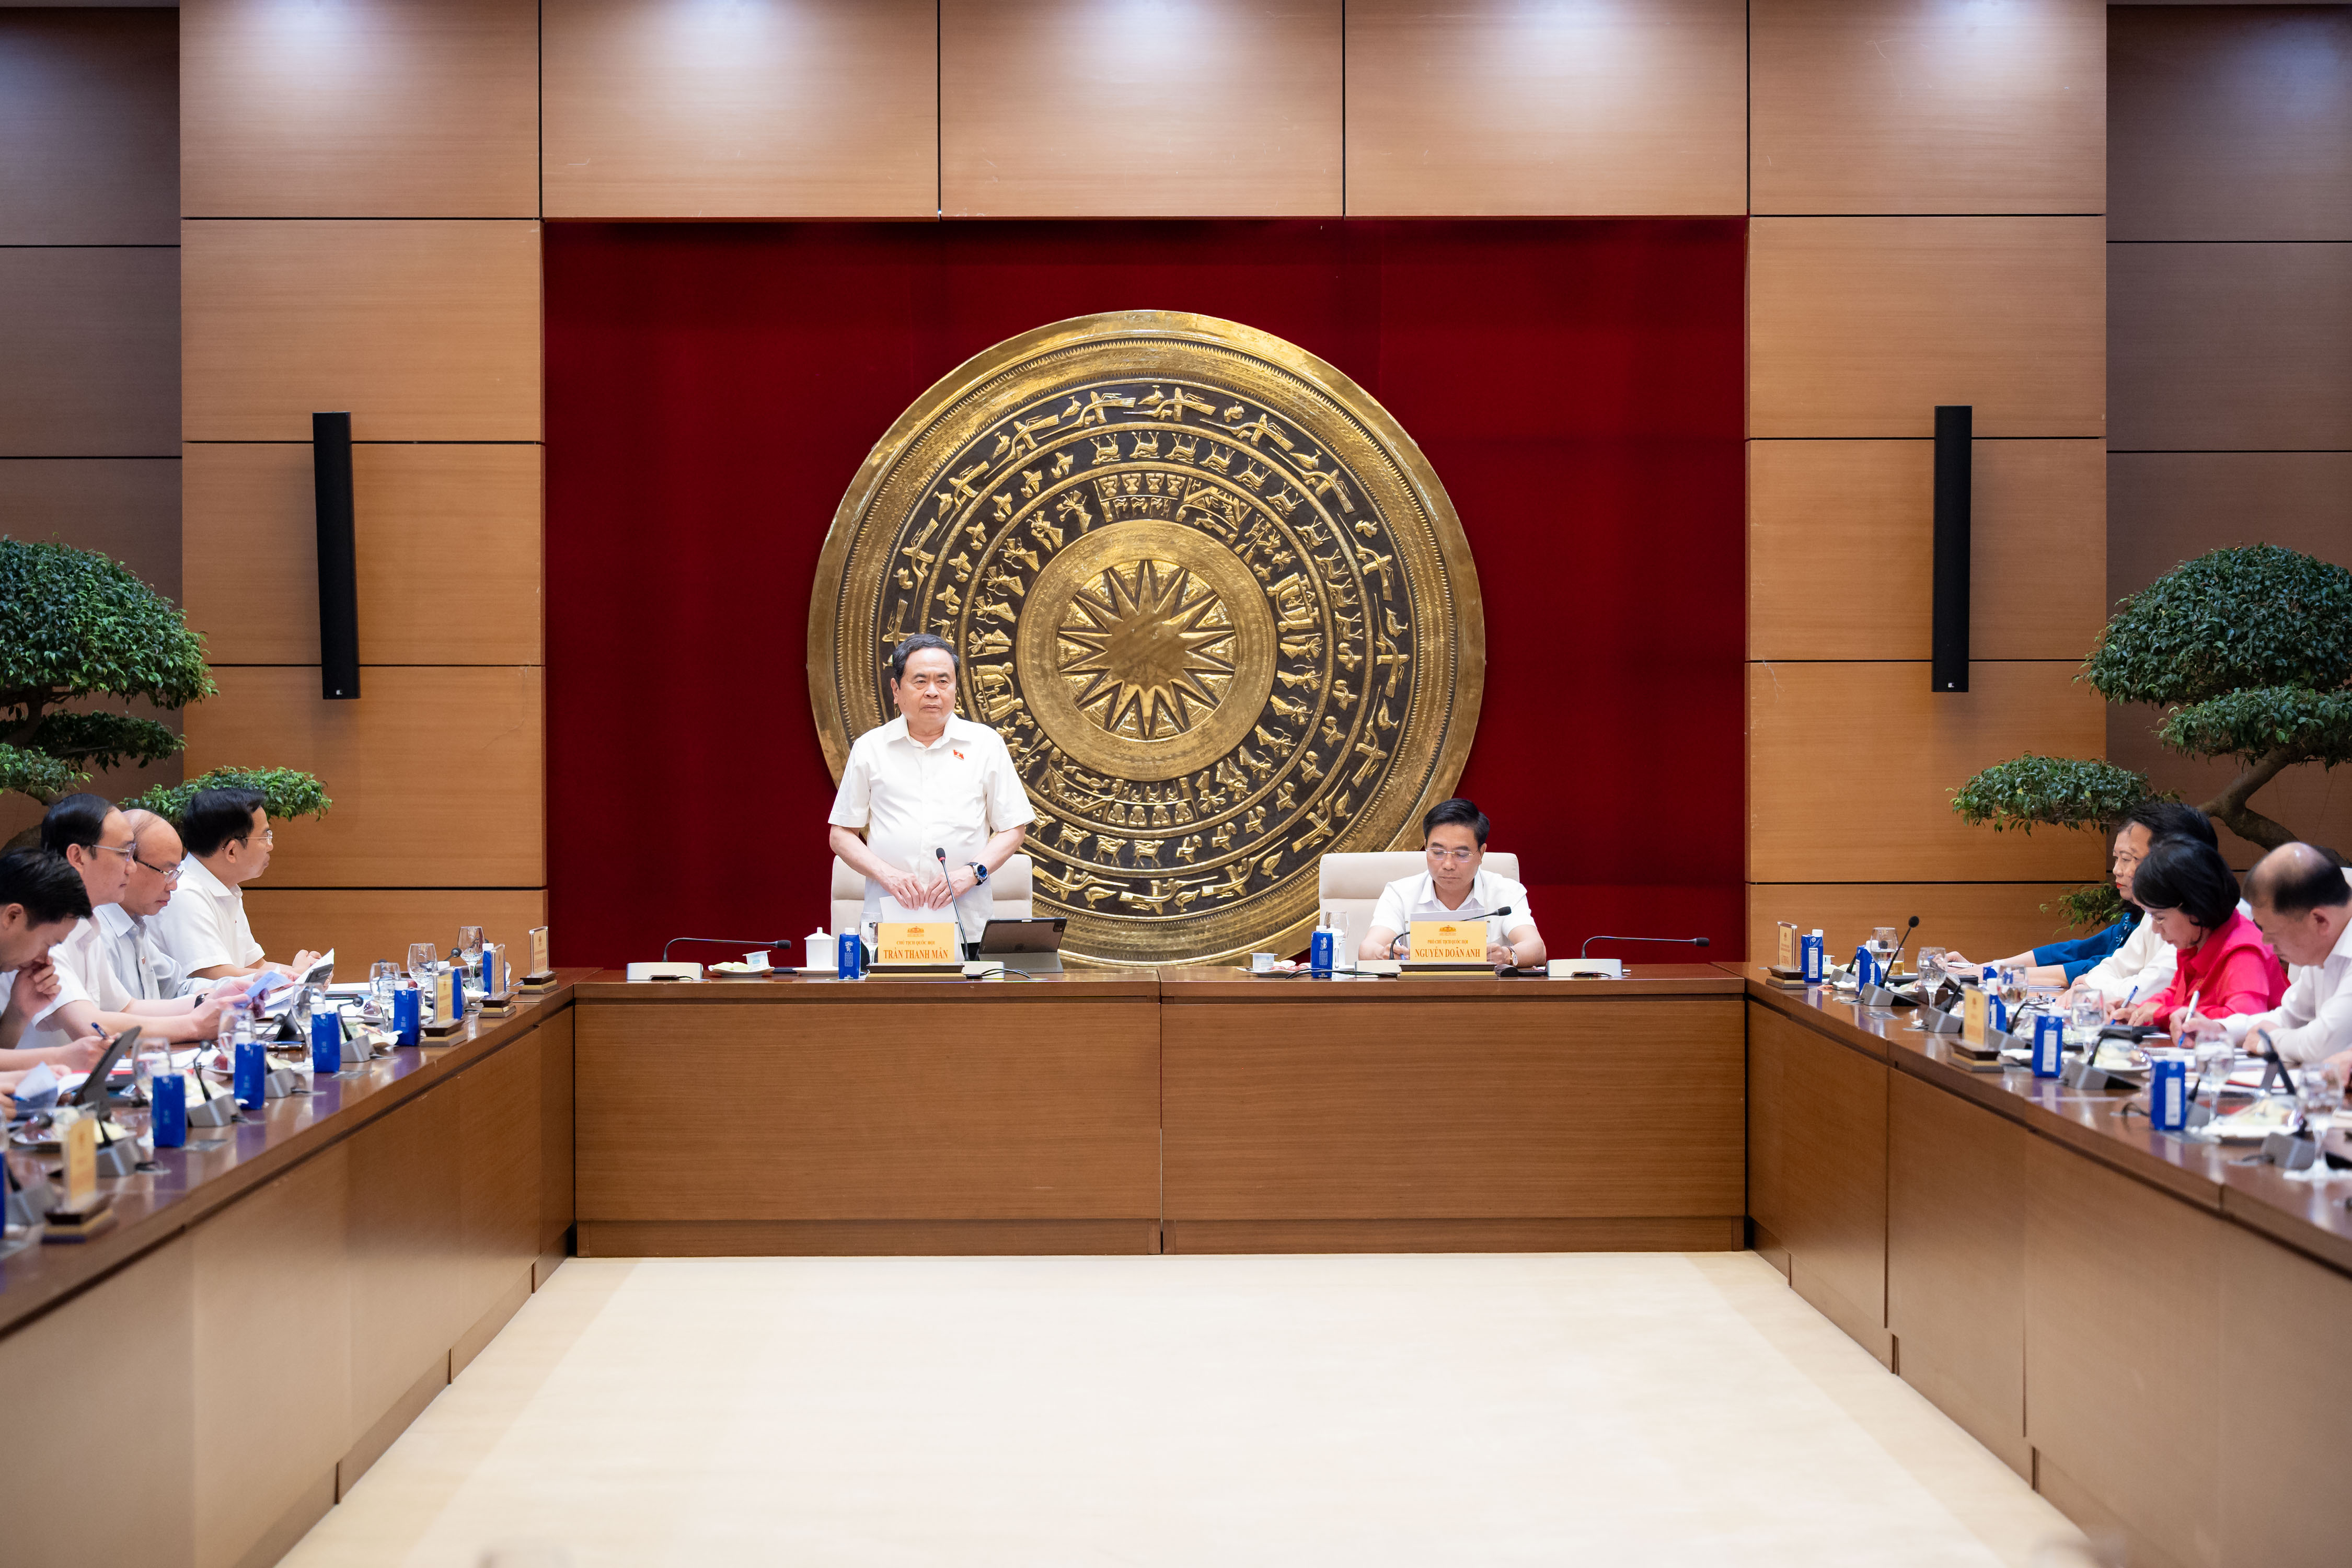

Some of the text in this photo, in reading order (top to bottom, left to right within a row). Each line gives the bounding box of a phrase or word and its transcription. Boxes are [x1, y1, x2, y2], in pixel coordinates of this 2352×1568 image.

[883, 947, 948, 959] TRẦN THANH MẪN
[1415, 946, 1480, 957] NGUYỄN DOÃN ANH
